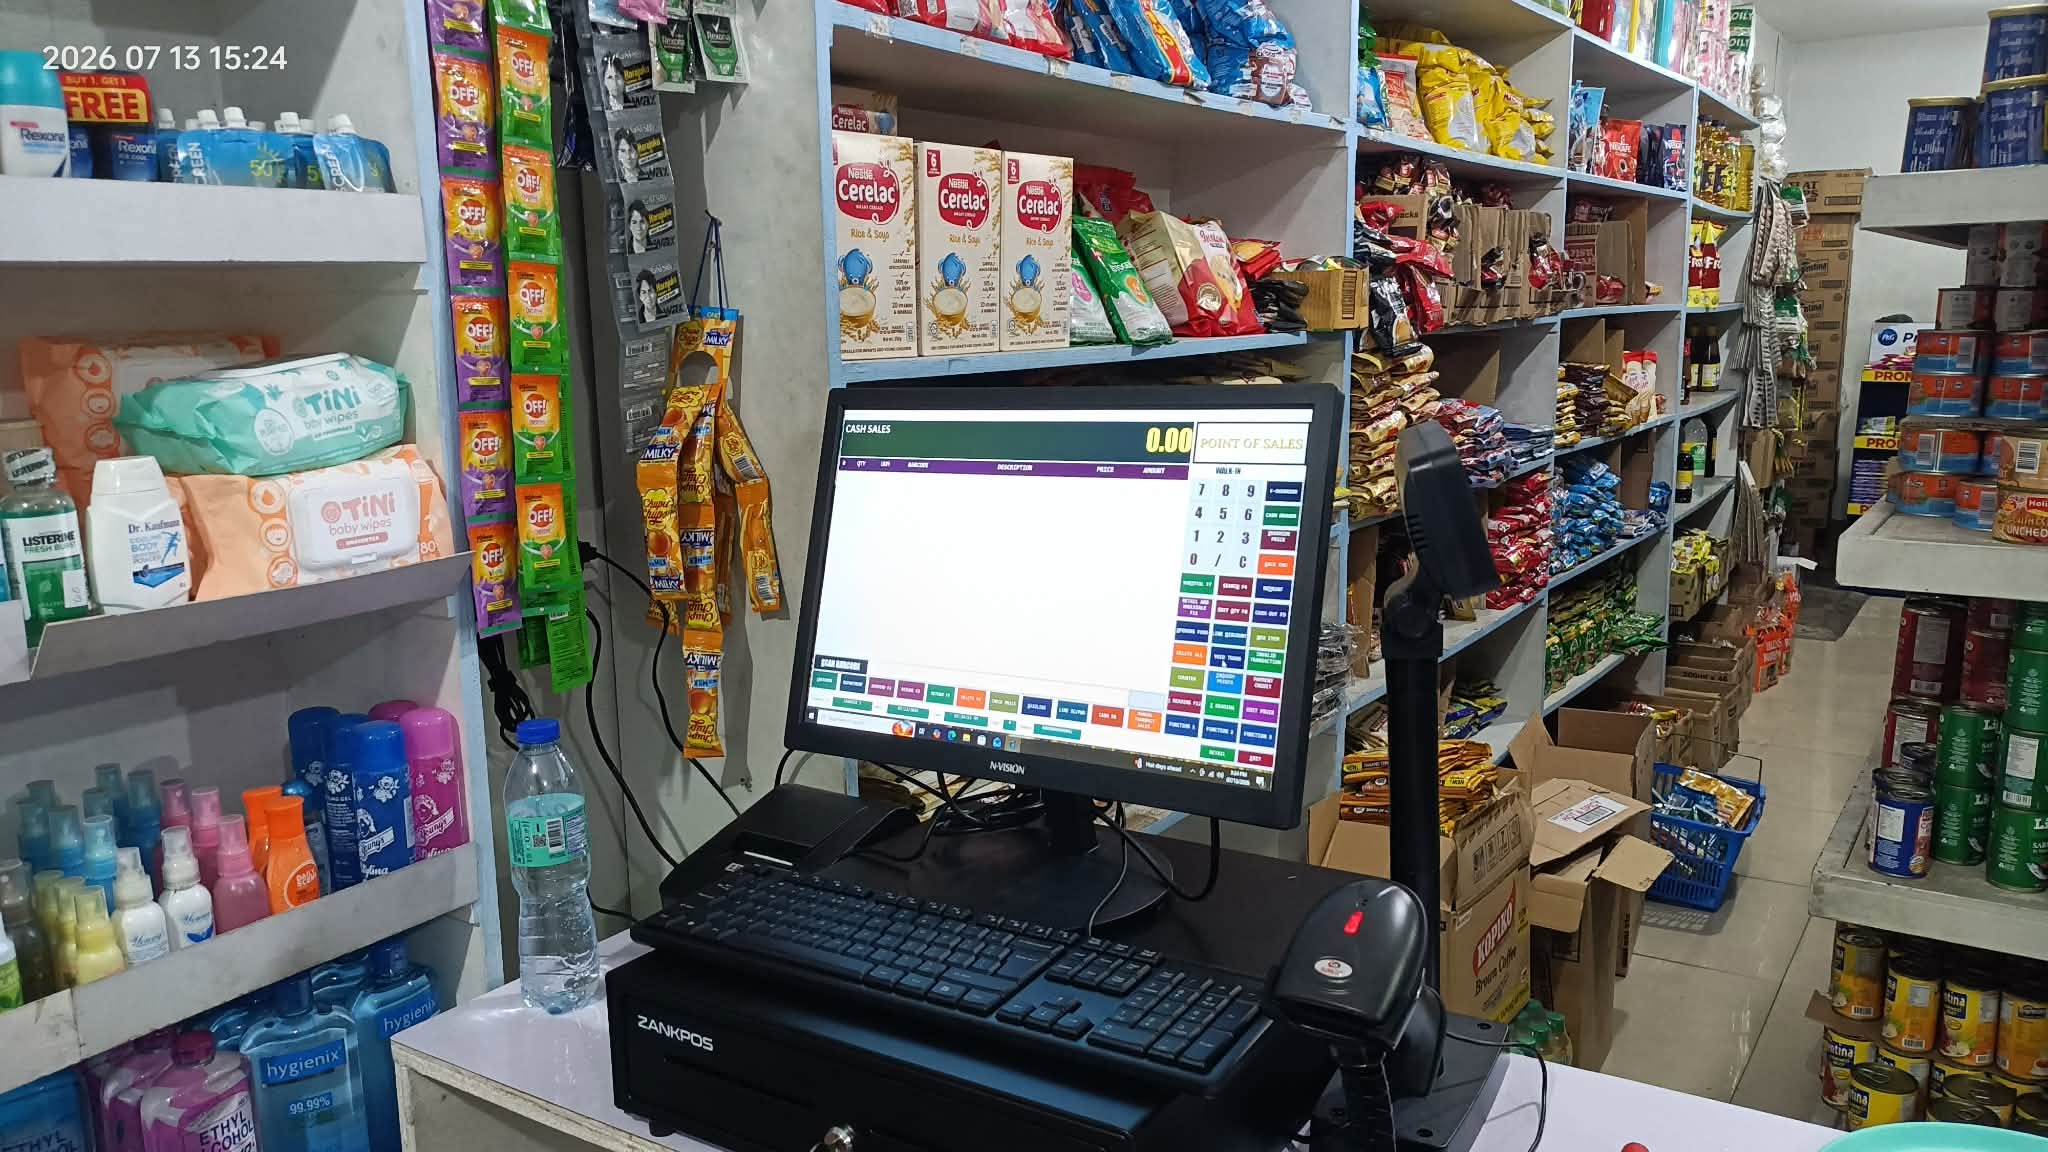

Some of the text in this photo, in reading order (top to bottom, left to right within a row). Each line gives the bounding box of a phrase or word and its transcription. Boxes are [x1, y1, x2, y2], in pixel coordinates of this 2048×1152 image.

[511, 57, 535, 76] OFF!
[65, 91, 139, 120] FREE
[832, 115, 867, 131] Cerelac
[930, 153, 937, 167] 6
[1010, 162, 1017, 175] 6
[838, 180, 895, 203] Cerelac
[940, 189, 987, 210] Cerelac
[1019, 195, 1059, 216] Cerelac
[458, 204, 487, 221] OFF!
[850, 229, 866, 238] Rice
[949, 234, 961, 244] Rice
[520, 288, 545, 304] OFF!
[465, 324, 494, 339] OFF!
[523, 402, 548, 415] OFF!
[325, 410, 360, 428] wipes
[845, 425, 891, 434] CASH SALES
[472, 437, 500, 451] OFF!
[1146, 427, 1193, 453] 0.00
[1200, 438, 1304, 450] POINT OF SALES
[1866, 438, 1900, 448] PRO
[645, 447, 674, 459] MILKY
[1199, 484, 1255, 497] 7 8 9
[343, 492, 396, 522] TiNi
[1195, 507, 1253, 521] 4 5 6
[529, 508, 554, 523] OFF!
[128, 519, 180, 535] Dr. Kaufmann
[329, 517, 392, 537] baby wipes
[23, 531, 75, 547] LISTERINE
[681, 531, 713, 542] MILKY
[1194, 530, 1250, 544] 1 2 3
[24, 544, 52, 554] FRESH
[131, 542, 158, 553] BODY
[481, 549, 504, 564] OFF!
[1190, 553, 1247, 568] 0 / C
[655, 581, 680, 591] MILKY
[687, 654, 717, 666] MILKY
[989, 760, 1026, 775] N-VISION
[1477, 900, 1513, 969] KOPIKO
[1945, 992, 1967, 1006] tina
[384, 998, 436, 1032] hygienix
[636, 1014, 714, 1052] ZANKPOS
[267, 1048, 340, 1078] hygienix
[289, 1095, 331, 1114] 99.99%
